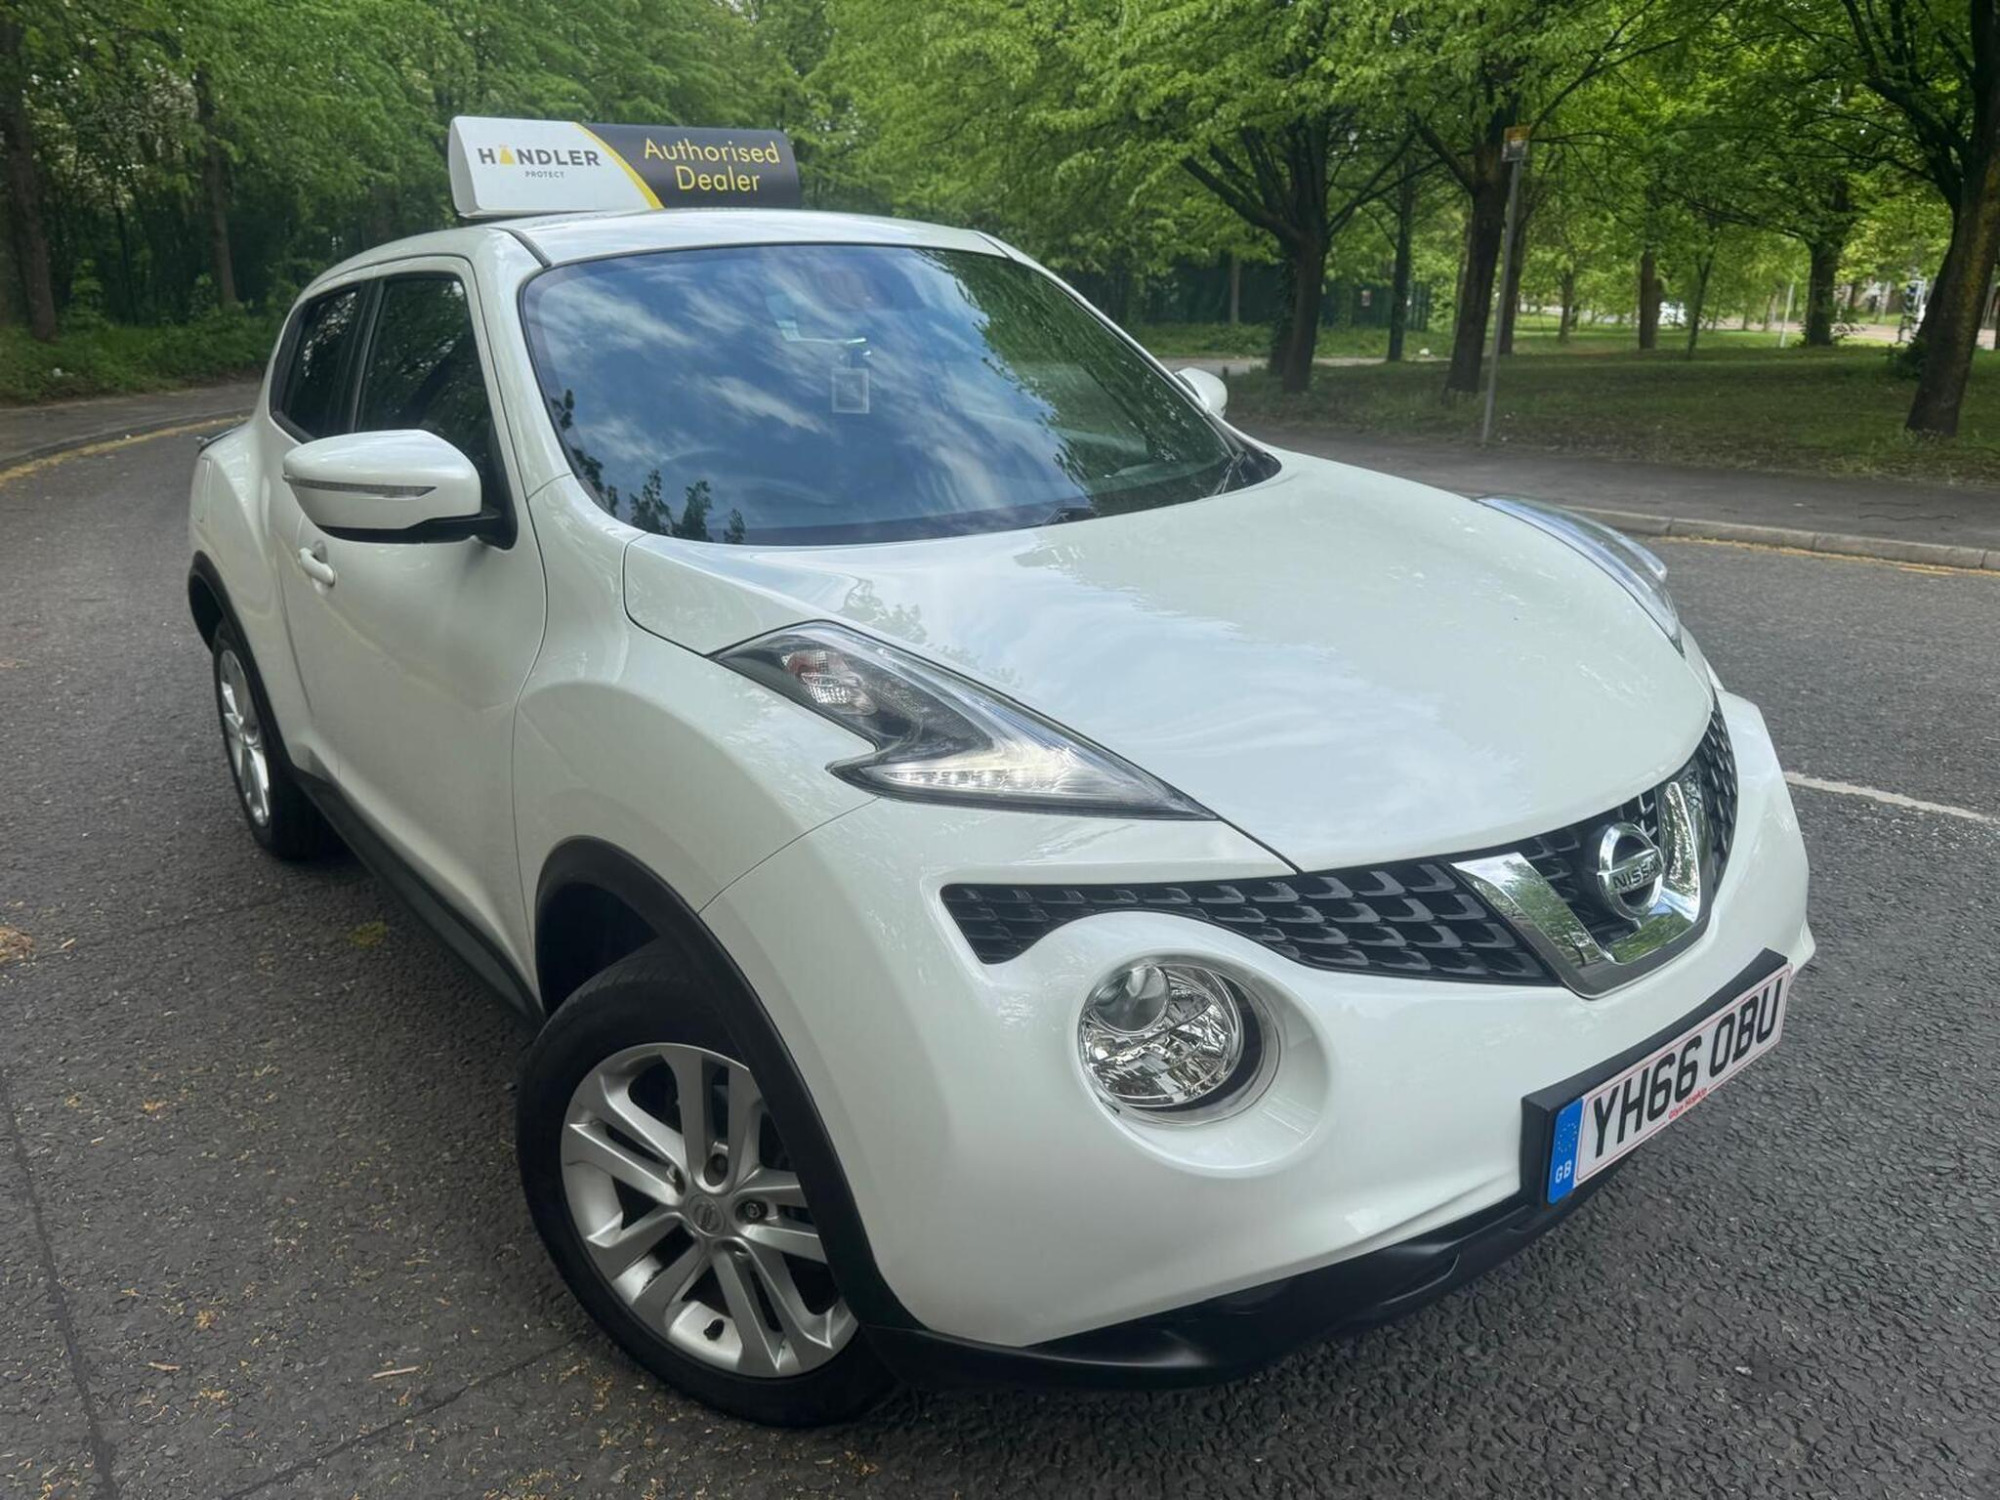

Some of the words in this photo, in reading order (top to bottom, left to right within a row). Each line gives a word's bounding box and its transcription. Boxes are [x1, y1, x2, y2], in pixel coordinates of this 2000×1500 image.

[644, 137, 780, 164] Authorised
[524, 170, 565, 179] PROTECT
[675, 165, 761, 192] Dealer
[1594, 1035, 1702, 1159] YH66
[1708, 978, 1783, 1078] OBU
[1555, 1159, 1573, 1184] GB
